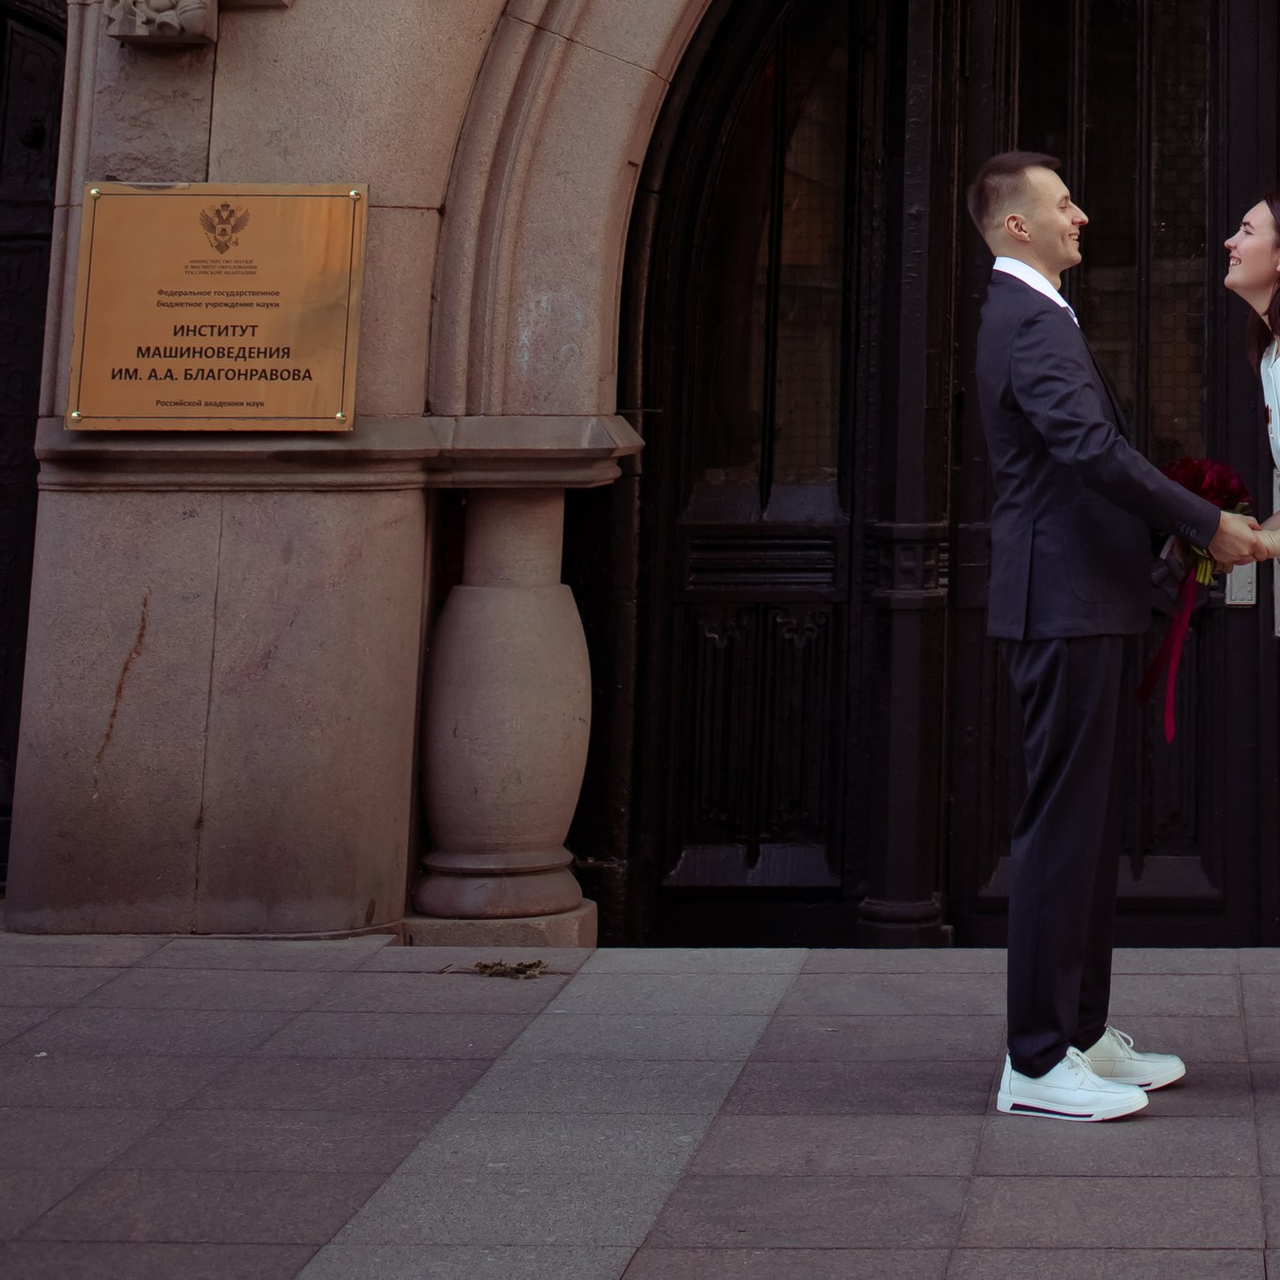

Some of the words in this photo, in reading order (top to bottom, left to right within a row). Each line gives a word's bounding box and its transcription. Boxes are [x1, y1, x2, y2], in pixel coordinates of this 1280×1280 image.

[256, 301, 280, 309] науки
[173, 324, 259, 337] ИНСТИТУТ
[136, 346, 291, 361] МАШИНОВЕДЕНИЯ
[111, 367, 143, 381] ИМ.
[147, 368, 179, 381] А.А.
[183, 368, 313, 381] БЛАГОНРАВОВА
